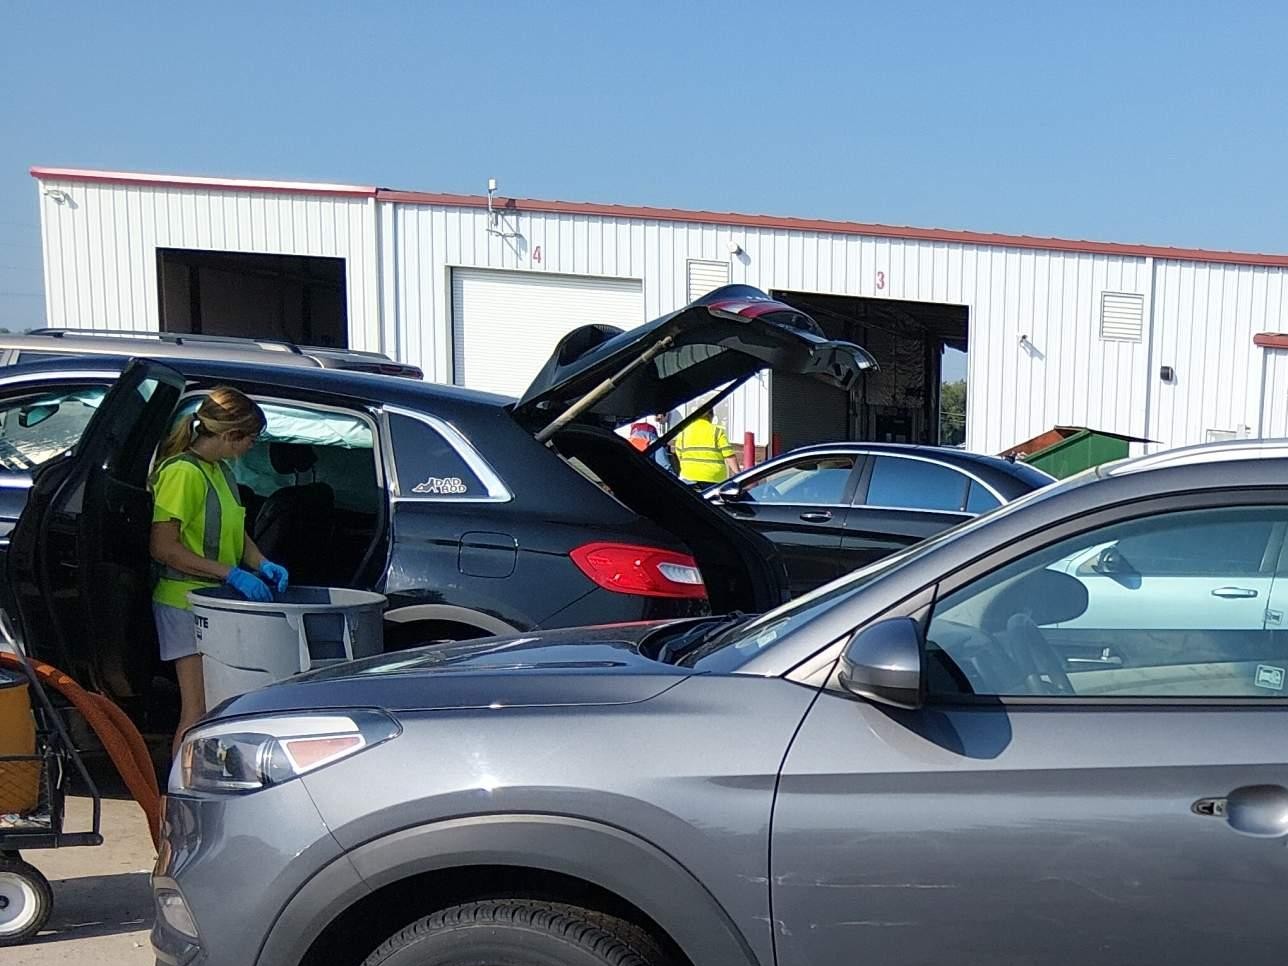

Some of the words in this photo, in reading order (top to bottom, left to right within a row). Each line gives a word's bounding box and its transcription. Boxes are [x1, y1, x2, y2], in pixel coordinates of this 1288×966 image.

[533, 245, 541, 263] 4
[876, 270, 885, 290] 3
[435, 477, 462, 487] DAD
